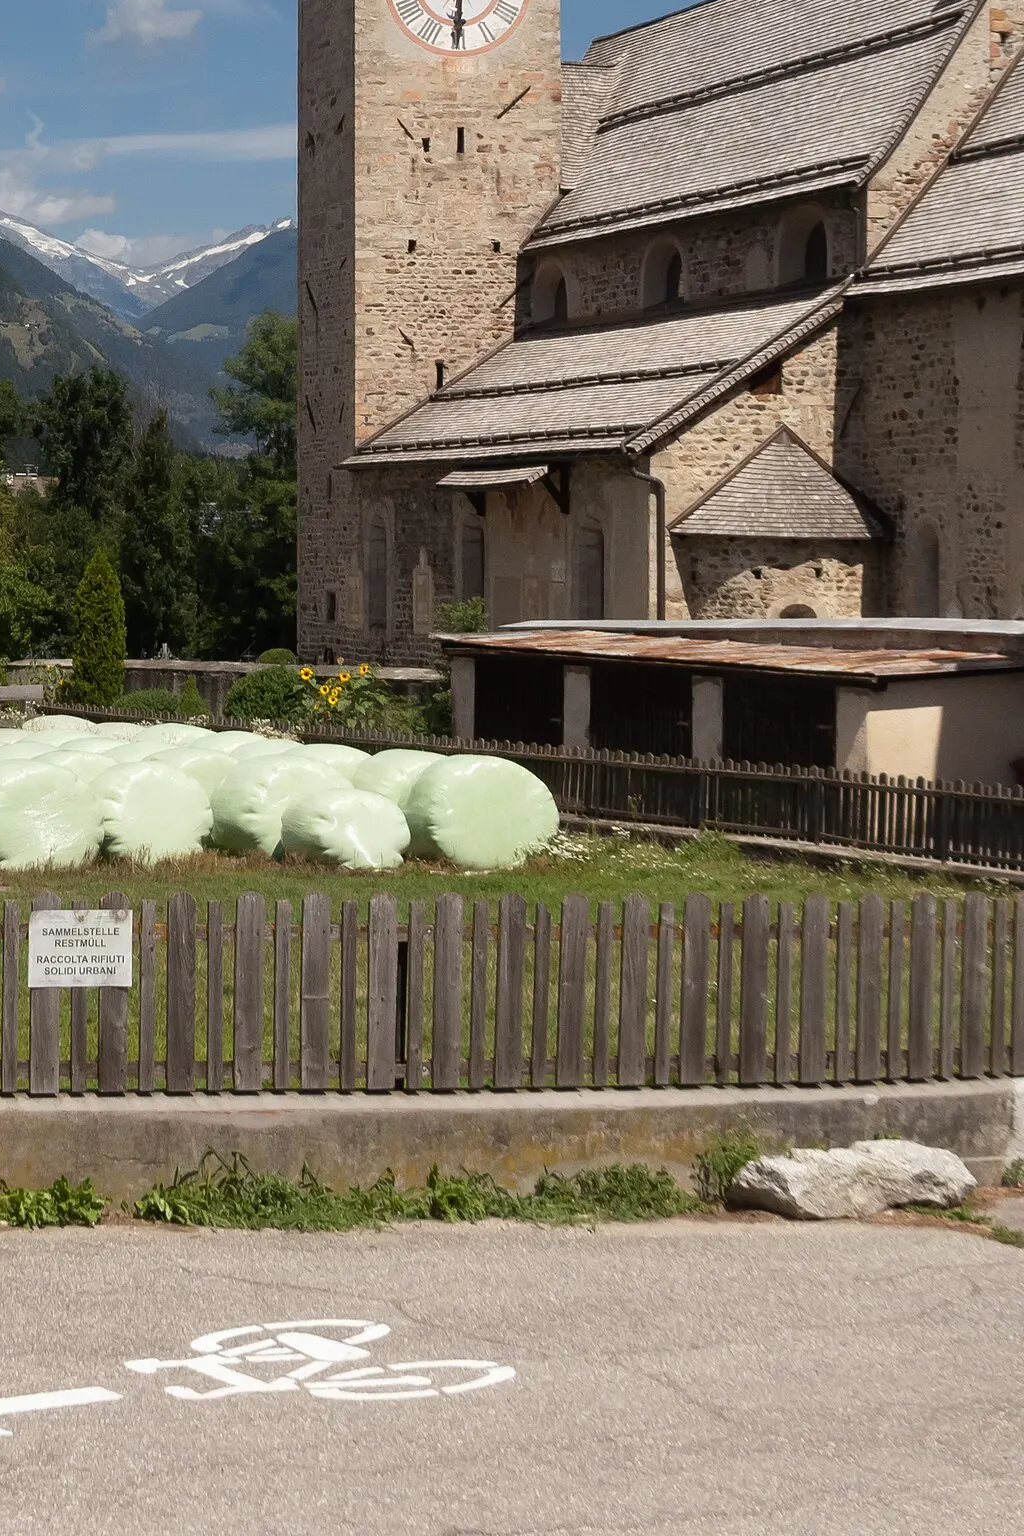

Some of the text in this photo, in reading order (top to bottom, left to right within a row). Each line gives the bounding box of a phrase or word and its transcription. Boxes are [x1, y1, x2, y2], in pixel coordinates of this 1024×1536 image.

[42, 927, 120, 936] SAMMELSTELLE
[54, 938, 106, 947] RESTMÜLL
[36, 955, 125, 964] RACCOLTA RIFIUTI
[44, 966, 116, 975] SOLIDI URBANI
